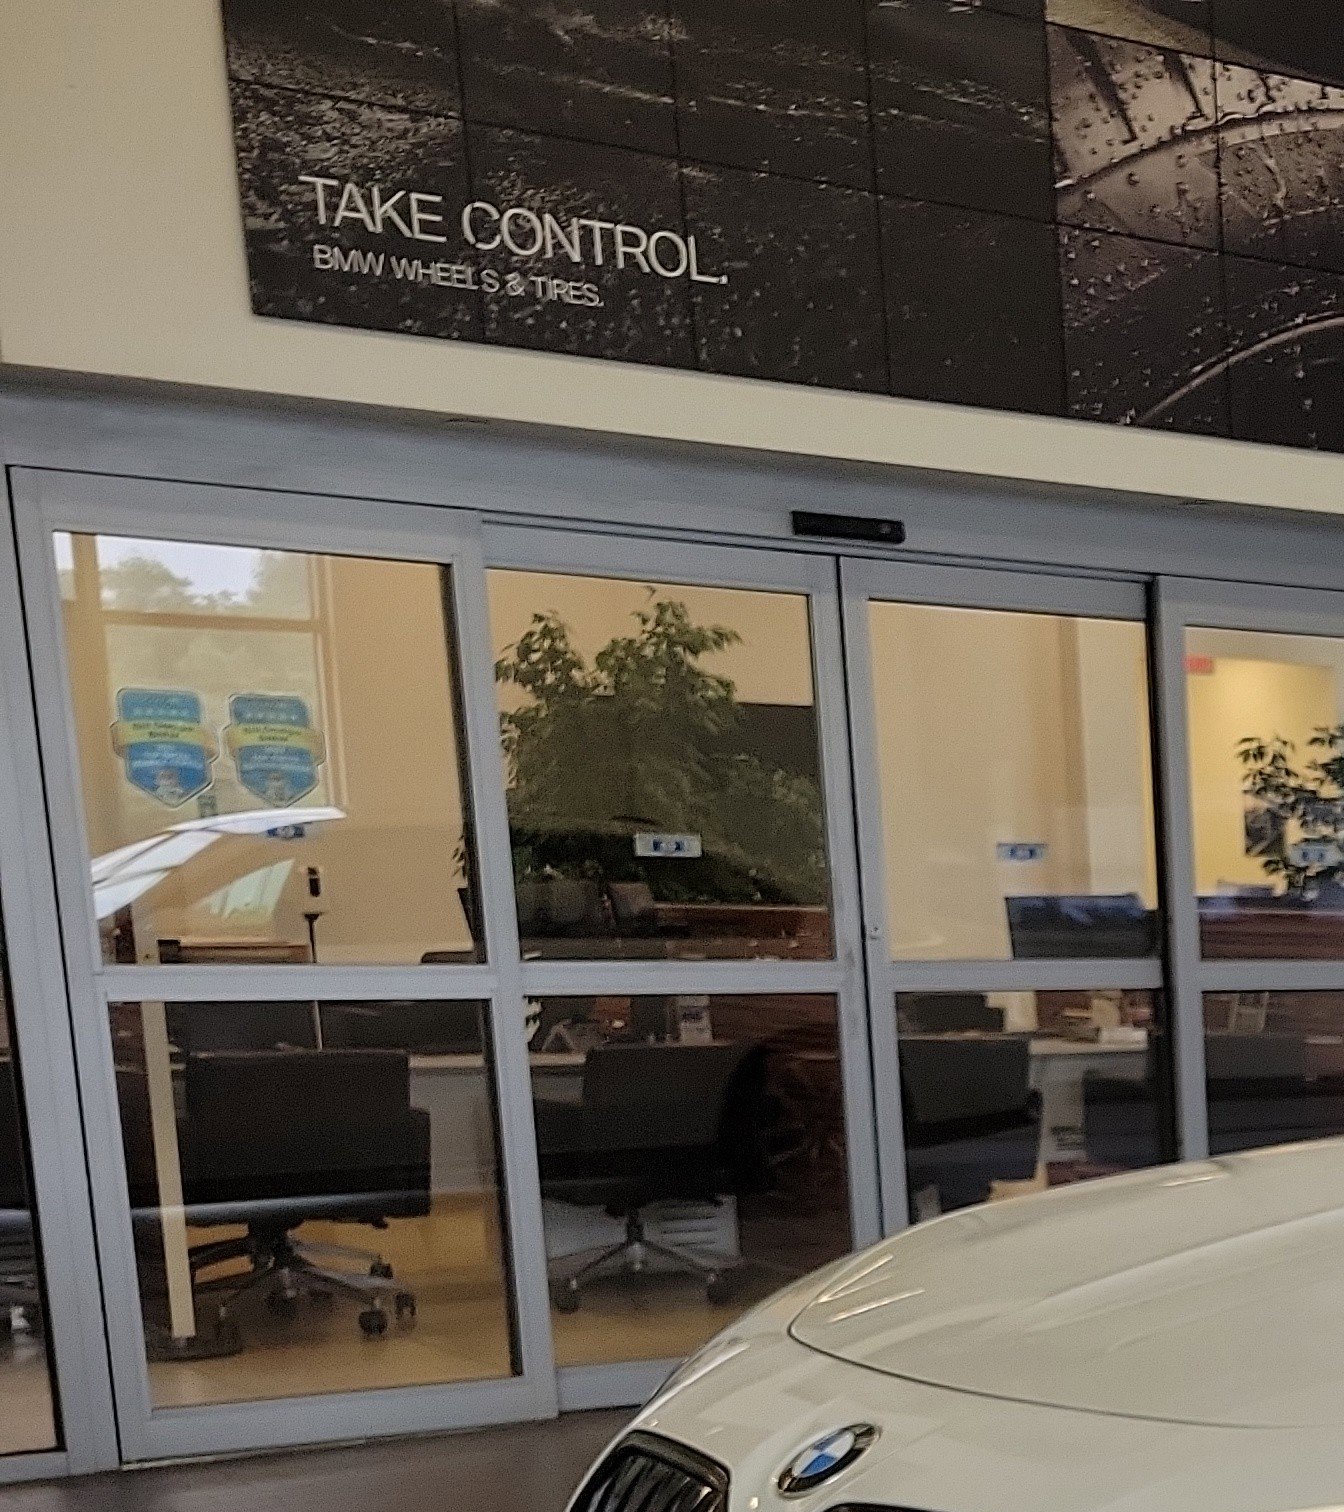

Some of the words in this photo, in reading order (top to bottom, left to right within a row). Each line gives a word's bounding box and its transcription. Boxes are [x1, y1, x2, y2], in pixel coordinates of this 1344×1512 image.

[298, 175, 447, 243] TAKE
[461, 201, 729, 285] CONTROL.
[313, 243, 385, 277] BMW
[390, 255, 500, 293] WHEELS
[504, 271, 525, 297] &
[530, 275, 605, 308] TIRES.
